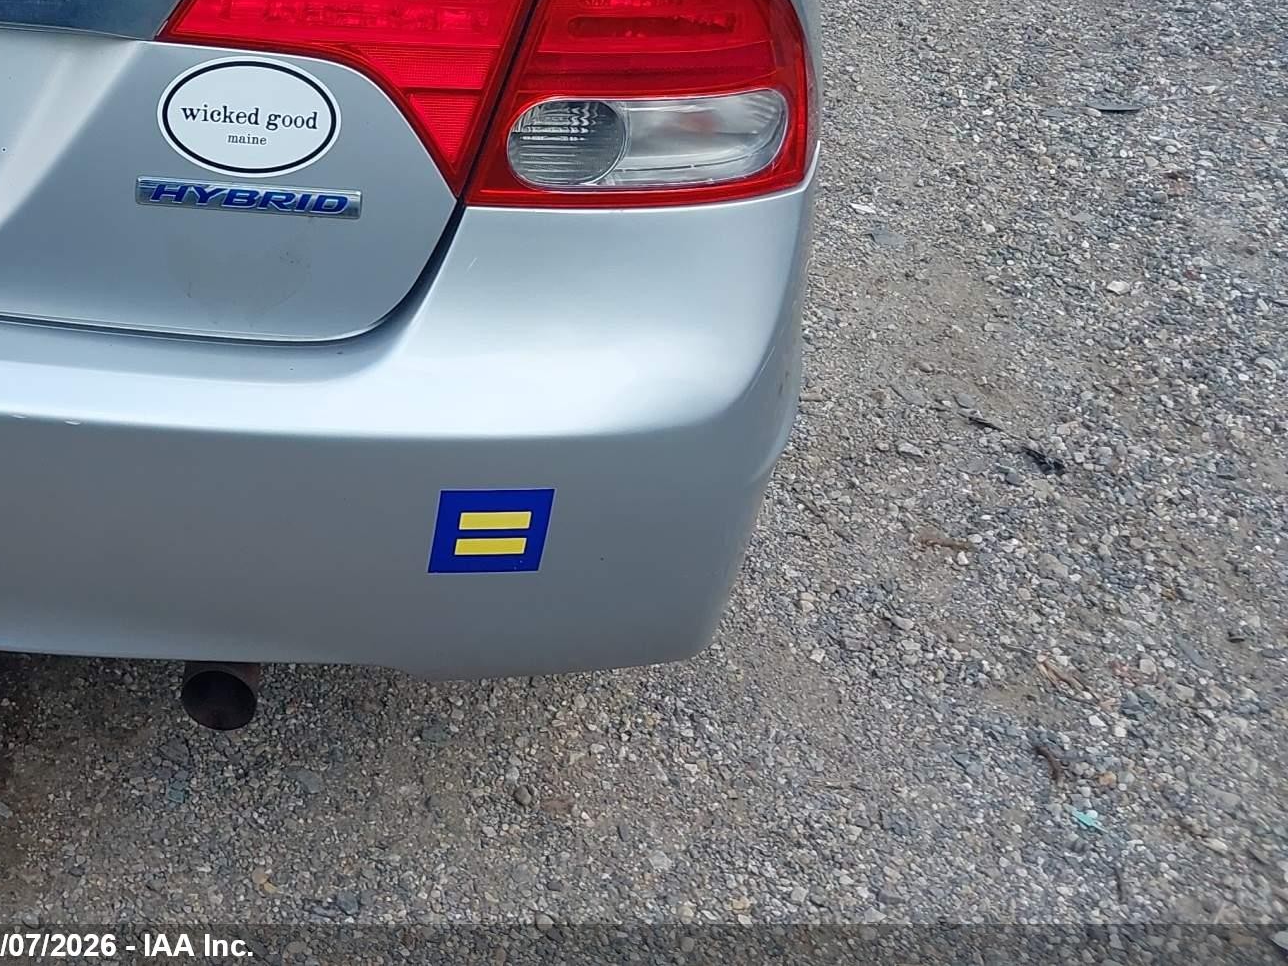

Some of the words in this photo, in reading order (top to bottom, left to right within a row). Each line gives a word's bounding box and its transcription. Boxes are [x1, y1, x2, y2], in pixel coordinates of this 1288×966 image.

[181, 103, 260, 126] wicked
[265, 111, 318, 131] good
[227, 132, 267, 146] maine
[149, 183, 351, 216] HYBRID
